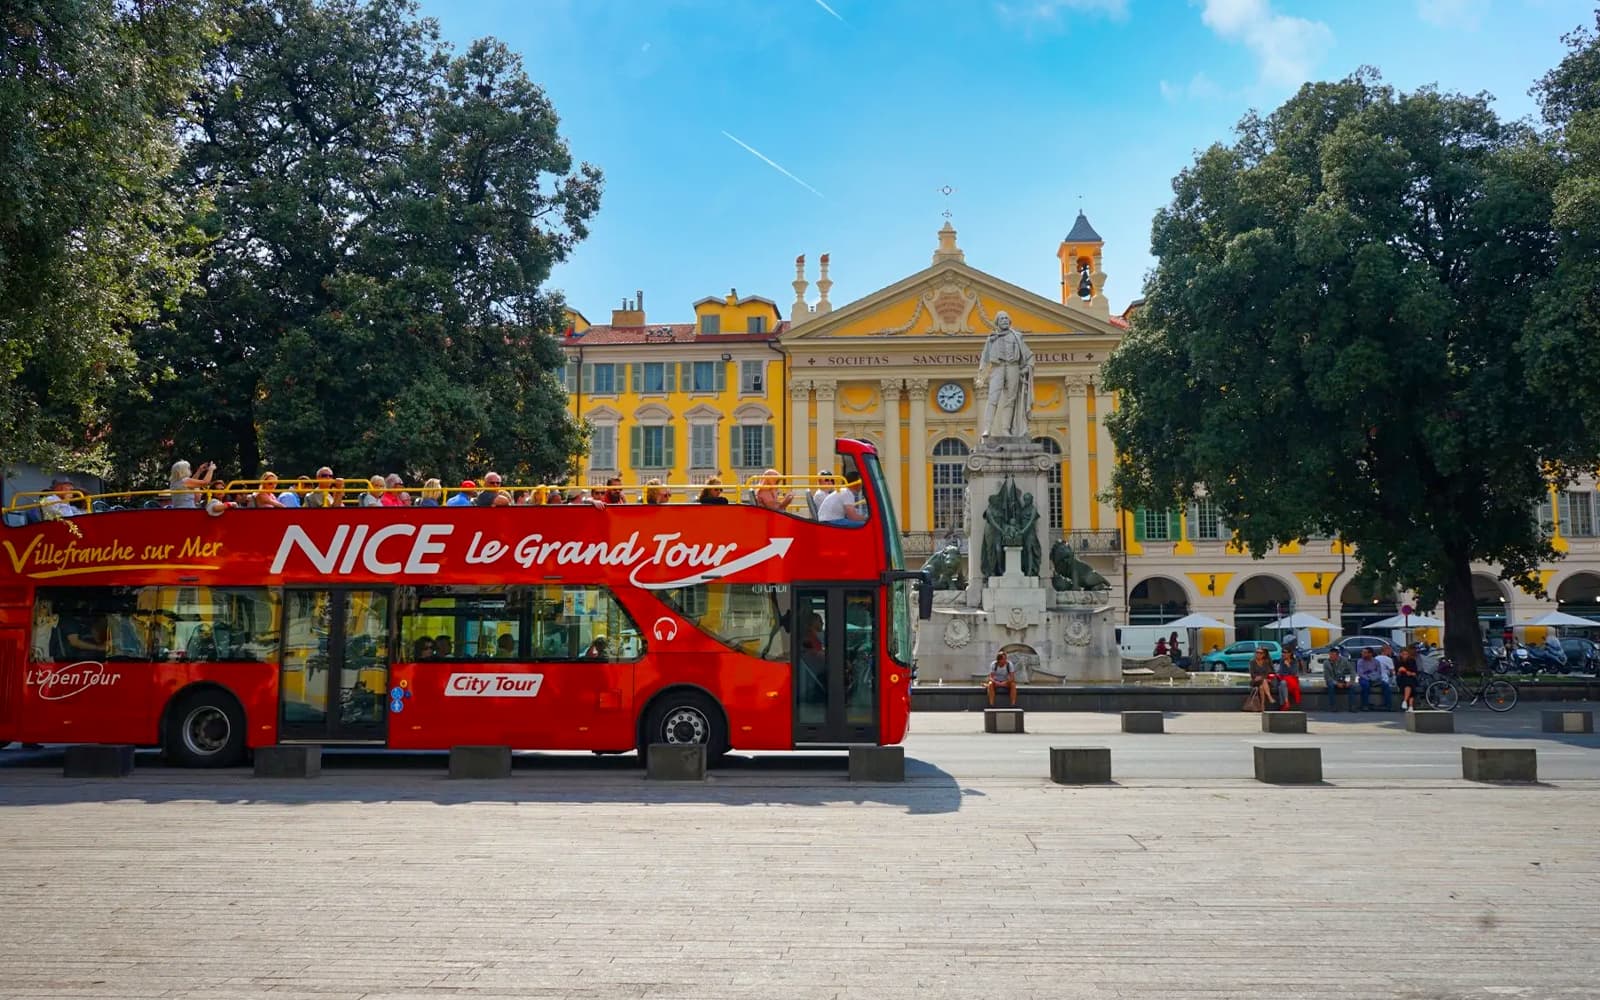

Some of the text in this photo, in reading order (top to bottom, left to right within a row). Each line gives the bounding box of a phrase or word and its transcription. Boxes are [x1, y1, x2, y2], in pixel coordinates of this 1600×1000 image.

[828, 353, 1075, 365] SOCIETAS SANCTISSIM ULCRI
[3, 534, 223, 574] Villefranche sur Mer
[270, 524, 455, 574] NICE
[513, 531, 645, 568] Grand
[651, 532, 737, 567] Tour
[453, 676, 537, 694] City Tour
